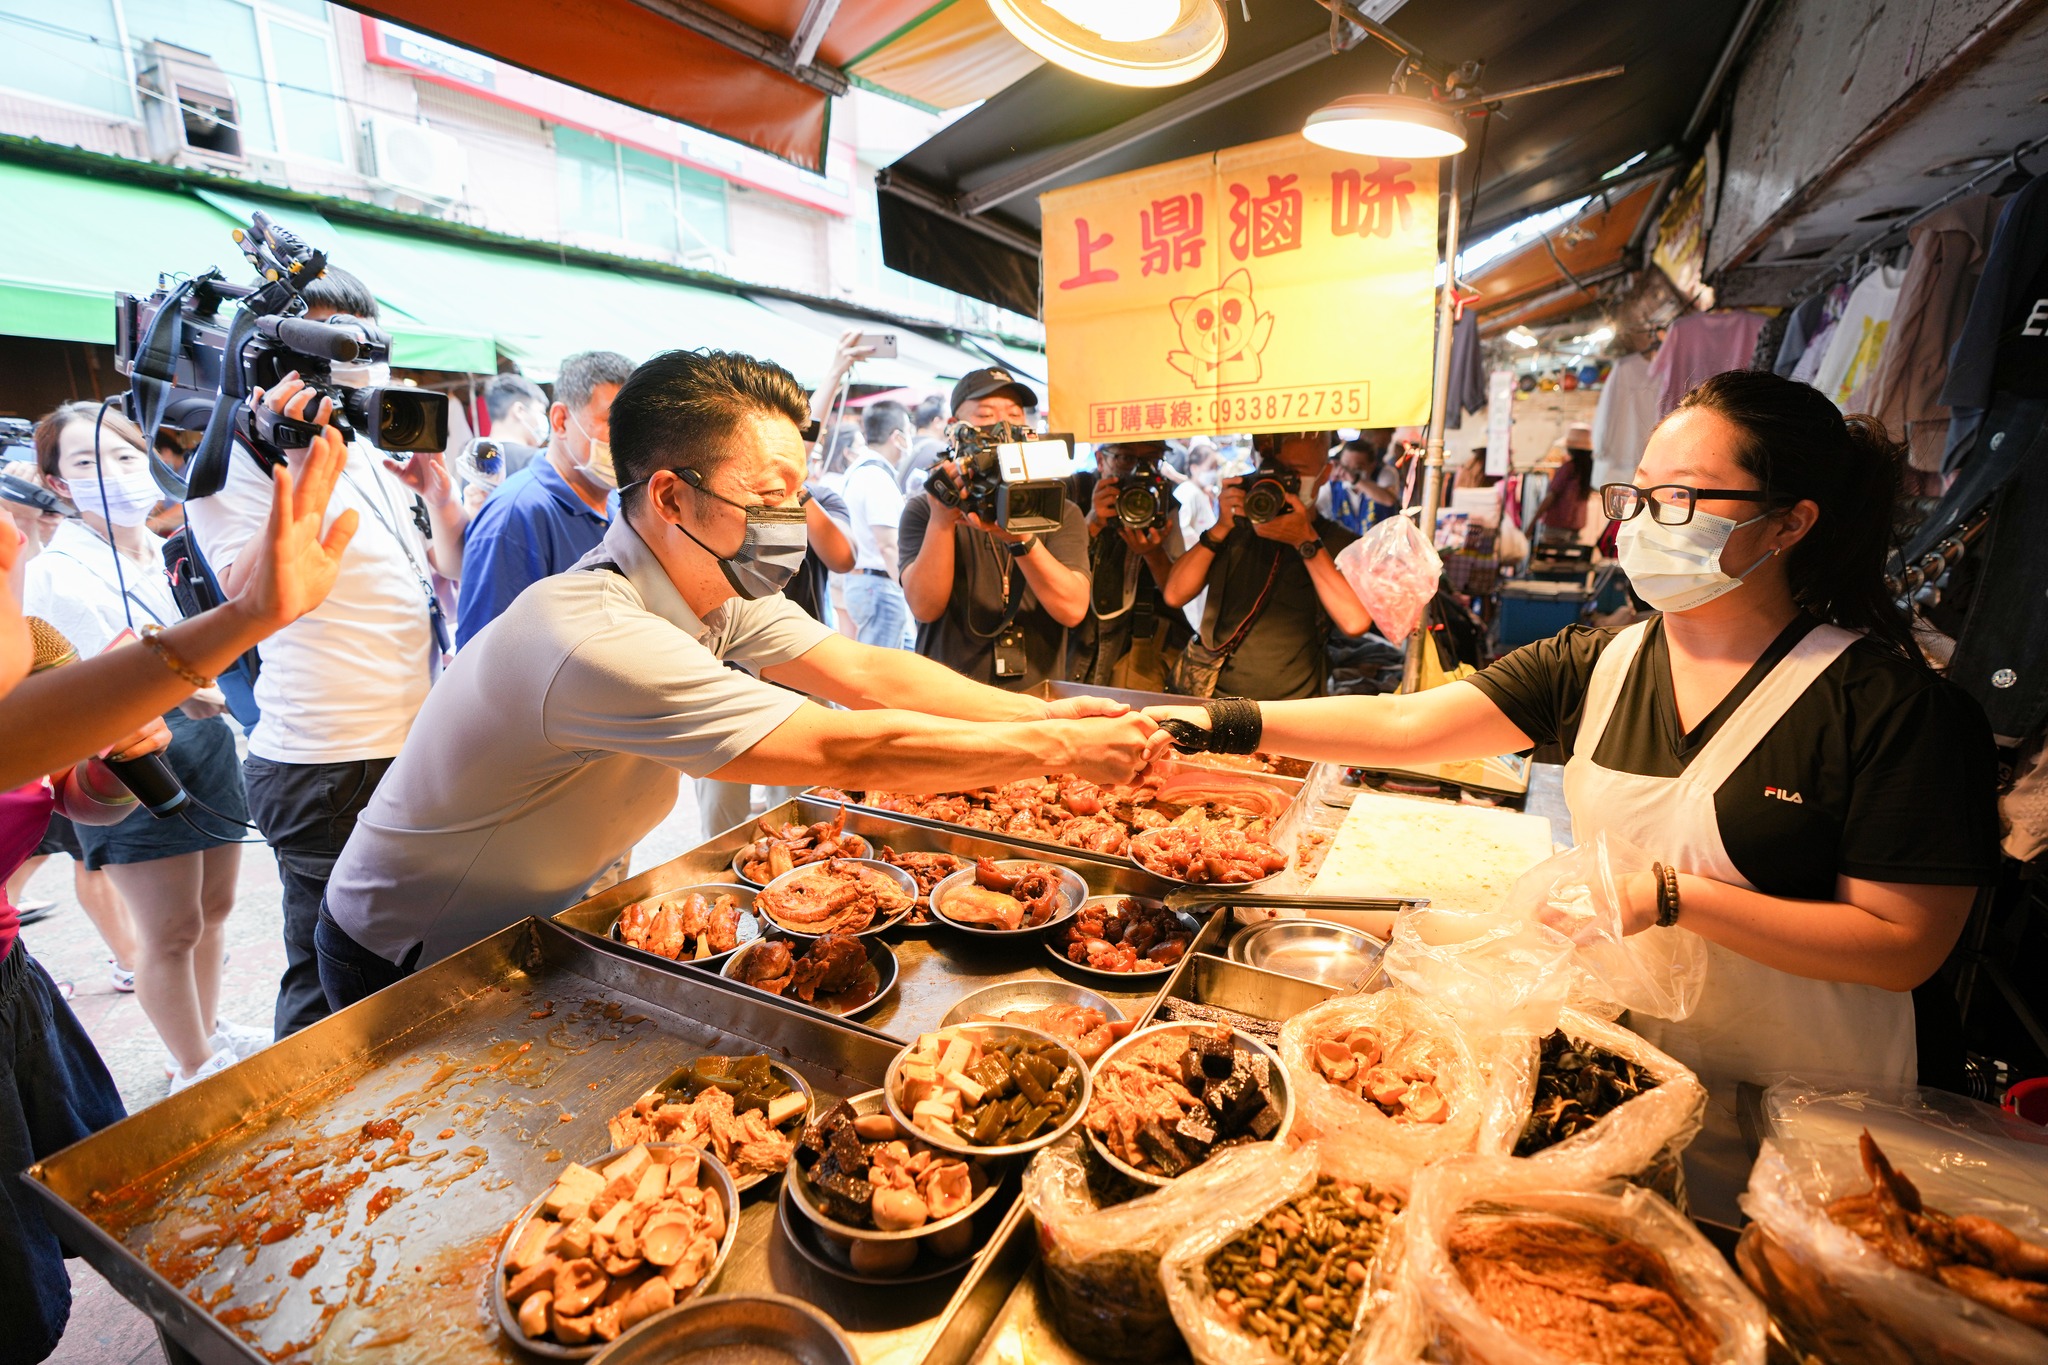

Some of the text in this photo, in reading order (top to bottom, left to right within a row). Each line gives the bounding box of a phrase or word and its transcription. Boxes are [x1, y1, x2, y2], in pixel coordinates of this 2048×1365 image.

[1059, 157, 1416, 290] 上鼎滷味
[2021, 298, 2048, 337] E
[1764, 786, 1803, 804] FILA
